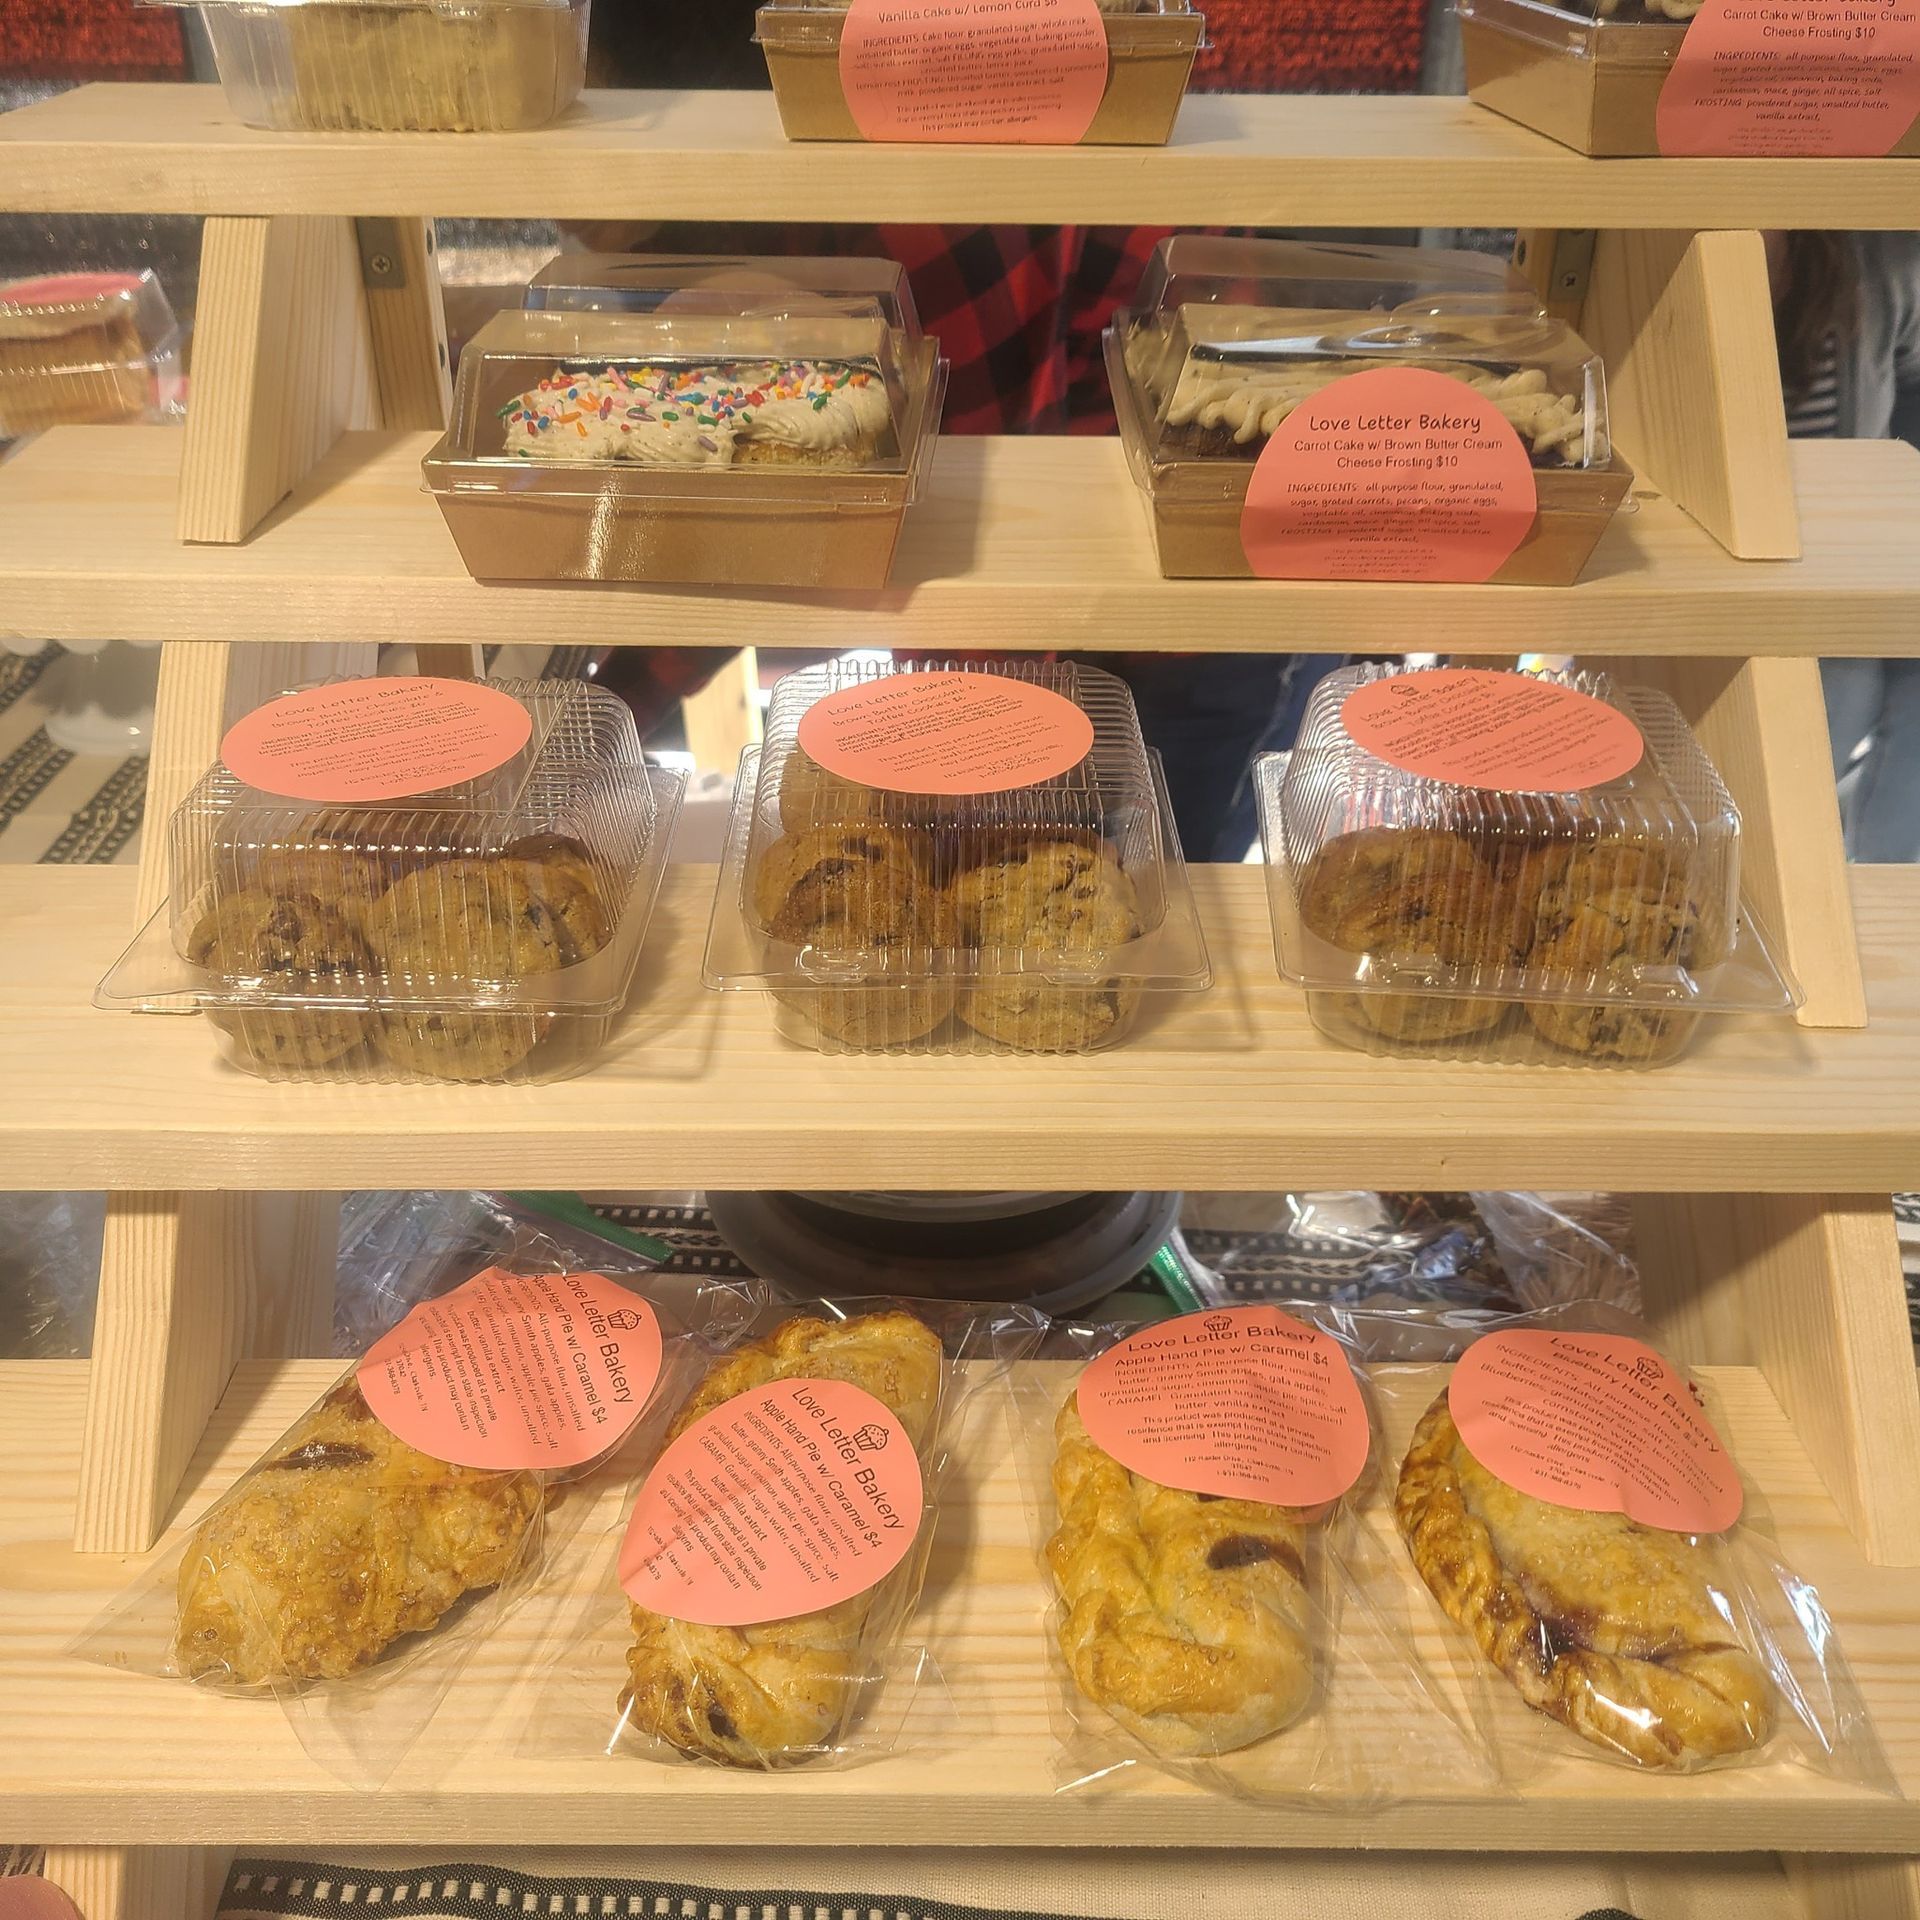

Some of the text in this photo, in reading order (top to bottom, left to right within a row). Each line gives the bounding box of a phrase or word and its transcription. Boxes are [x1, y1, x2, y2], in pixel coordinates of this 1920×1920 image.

[879, 11, 920, 24] Vanilla
[923, 8, 951, 19] Cake
[955, 5, 969, 16] w/
[973, 3, 1012, 14] Lemon
[1015, 0, 1038, 9] Curd
[1723, 9, 1916, 22] Carrot Cake w/ Brown Butter Cream
[1762, 26, 1876, 40] Cheese Frosting $10
[1785, 52, 1798, 61] all
[1745, 99, 1791, 109] powdered
[1310, 413, 1481, 433] Love Letter Bakery
[1294, 439, 1502, 451] Carrot Cake w/ Brown Butter Cream
[1337, 456, 1458, 470] Cheese Frosting $10
[1366, 482, 1380, 491] all
[1381, 483, 1418, 494] purpose
[1322, 496, 1353, 508] grated
[1434, 496, 1470, 507] organic
[275, 682, 434, 718] Love Letter Bakery
[828, 676, 963, 716] Love Letter Bakery
[832, 714, 870, 727] Brown
[872, 704, 908, 716] Butter
[521, 1313, 537, 1344] Smith
[558, 1313, 574, 1334] Pie
[562, 1273, 634, 1403] Love Letter Bakery
[566, 1335, 582, 1350] w/
[1128, 1324, 1316, 1352] Love Letter Bakery
[1115, 1343, 1328, 1368] Apple Hand Pie w/ Caramel $4
[488, 1359, 505, 1394] extract
[572, 1351, 601, 1406] Caramel
[1159, 1372, 1193, 1383] granny
[1196, 1368, 1227, 1378] Smith
[1269, 1375, 1290, 1386] gala
[1288, 1367, 1331, 1384] unsalted
[1100, 1385, 1158, 1399] granulated
[1551, 1338, 1720, 1452] Love Letter Bakery
[1553, 1352, 1618, 1384] Blueberry
[1622, 1383, 1658, 1410] Hand
[1661, 1411, 1680, 1430] Pie
[565, 1391, 586, 1431] unsalted
[591, 1406, 609, 1425] $4
[1213, 1400, 1249, 1409] vanilla
[1165, 1411, 1267, 1423] product was produced
[791, 1387, 904, 1531] Love Letter Bakery
[746, 1437, 767, 1459] granny
[765, 1457, 783, 1478] Smith
[800, 1505, 819, 1526] gala
[760, 1399, 883, 1549] Apple Hand Pie w/ Caramel $4
[780, 1448, 817, 1494] All-purpose
[830, 1517, 863, 1558] unsalted
[742, 1514, 768, 1543] extract
[776, 1499, 799, 1527] apple
[821, 1563, 839, 1582] salt
[747, 1545, 768, 1572] private
[788, 1543, 820, 1583] unsalted
